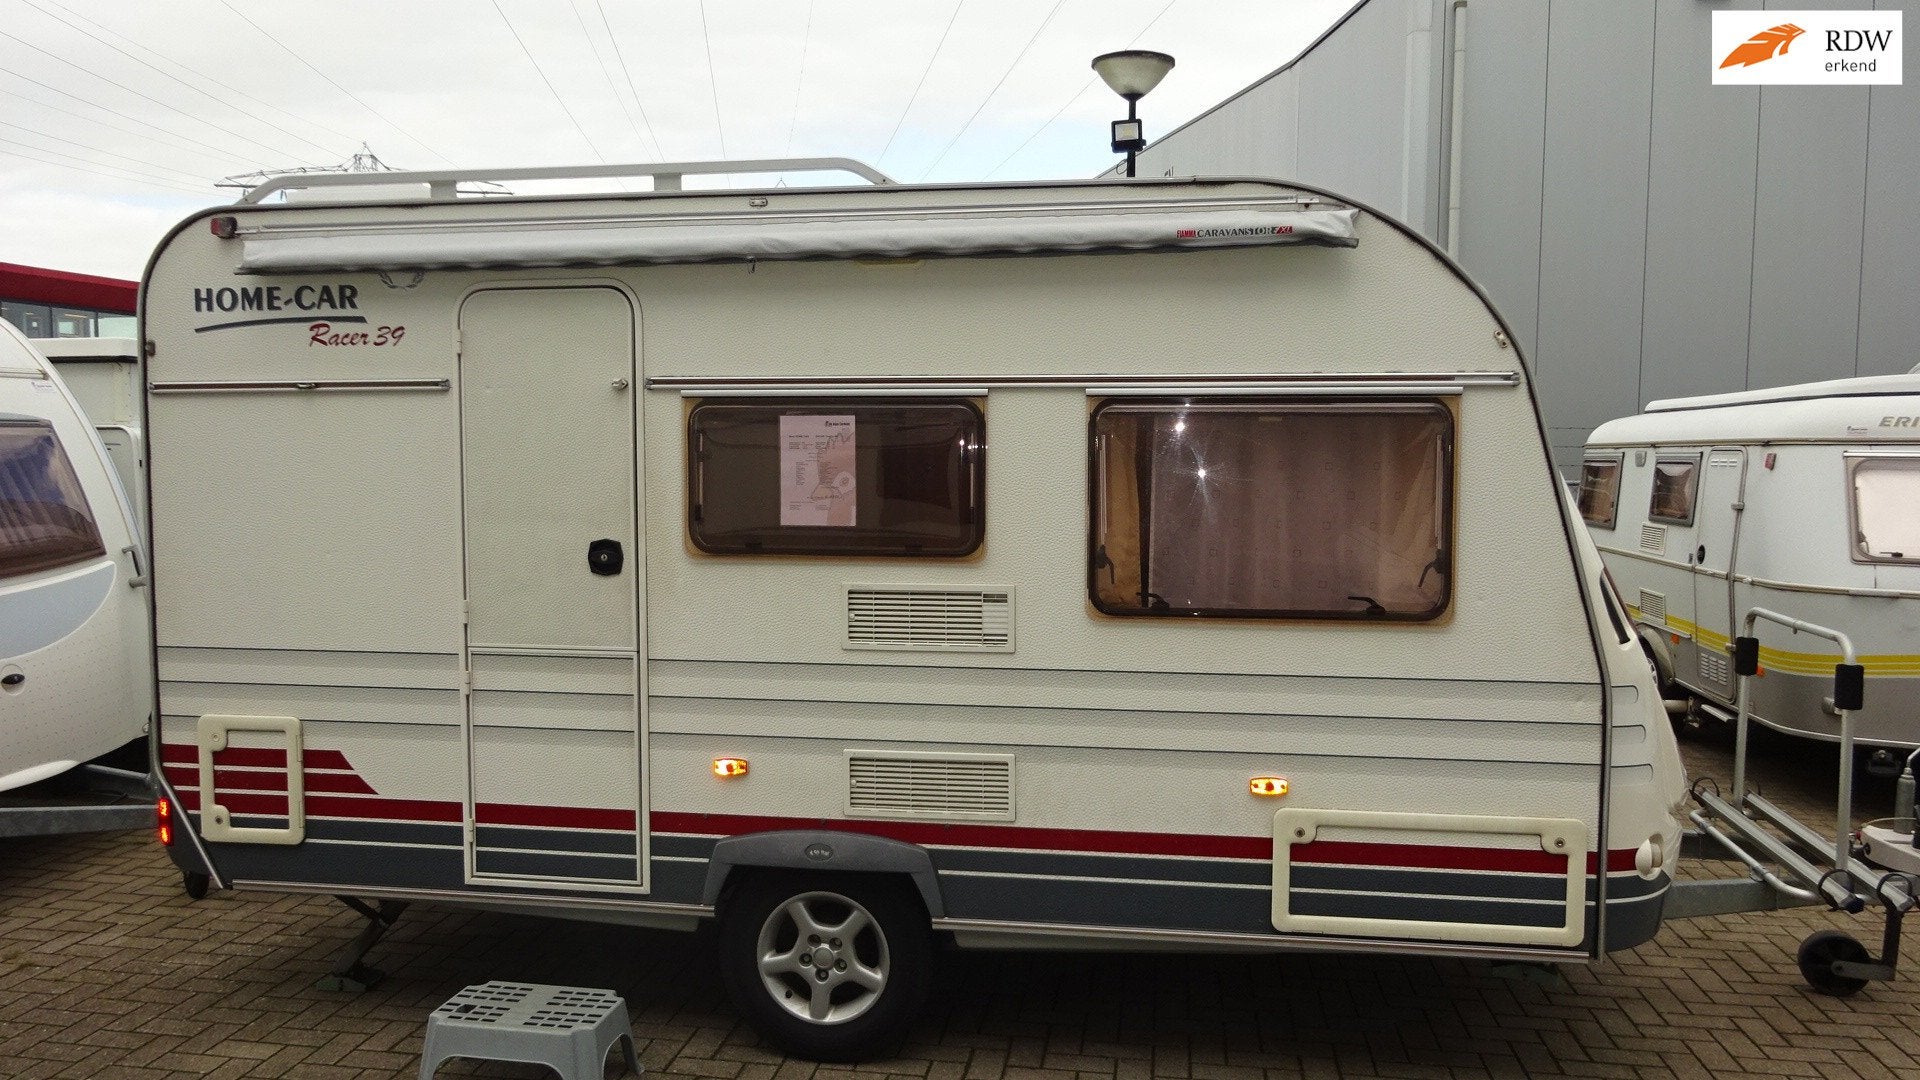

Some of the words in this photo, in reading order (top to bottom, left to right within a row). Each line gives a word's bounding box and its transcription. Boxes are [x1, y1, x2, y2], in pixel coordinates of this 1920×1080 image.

[194, 285, 359, 312] HOME-CAR
[309, 323, 369, 347] Racer
[372, 325, 406, 347] 39
